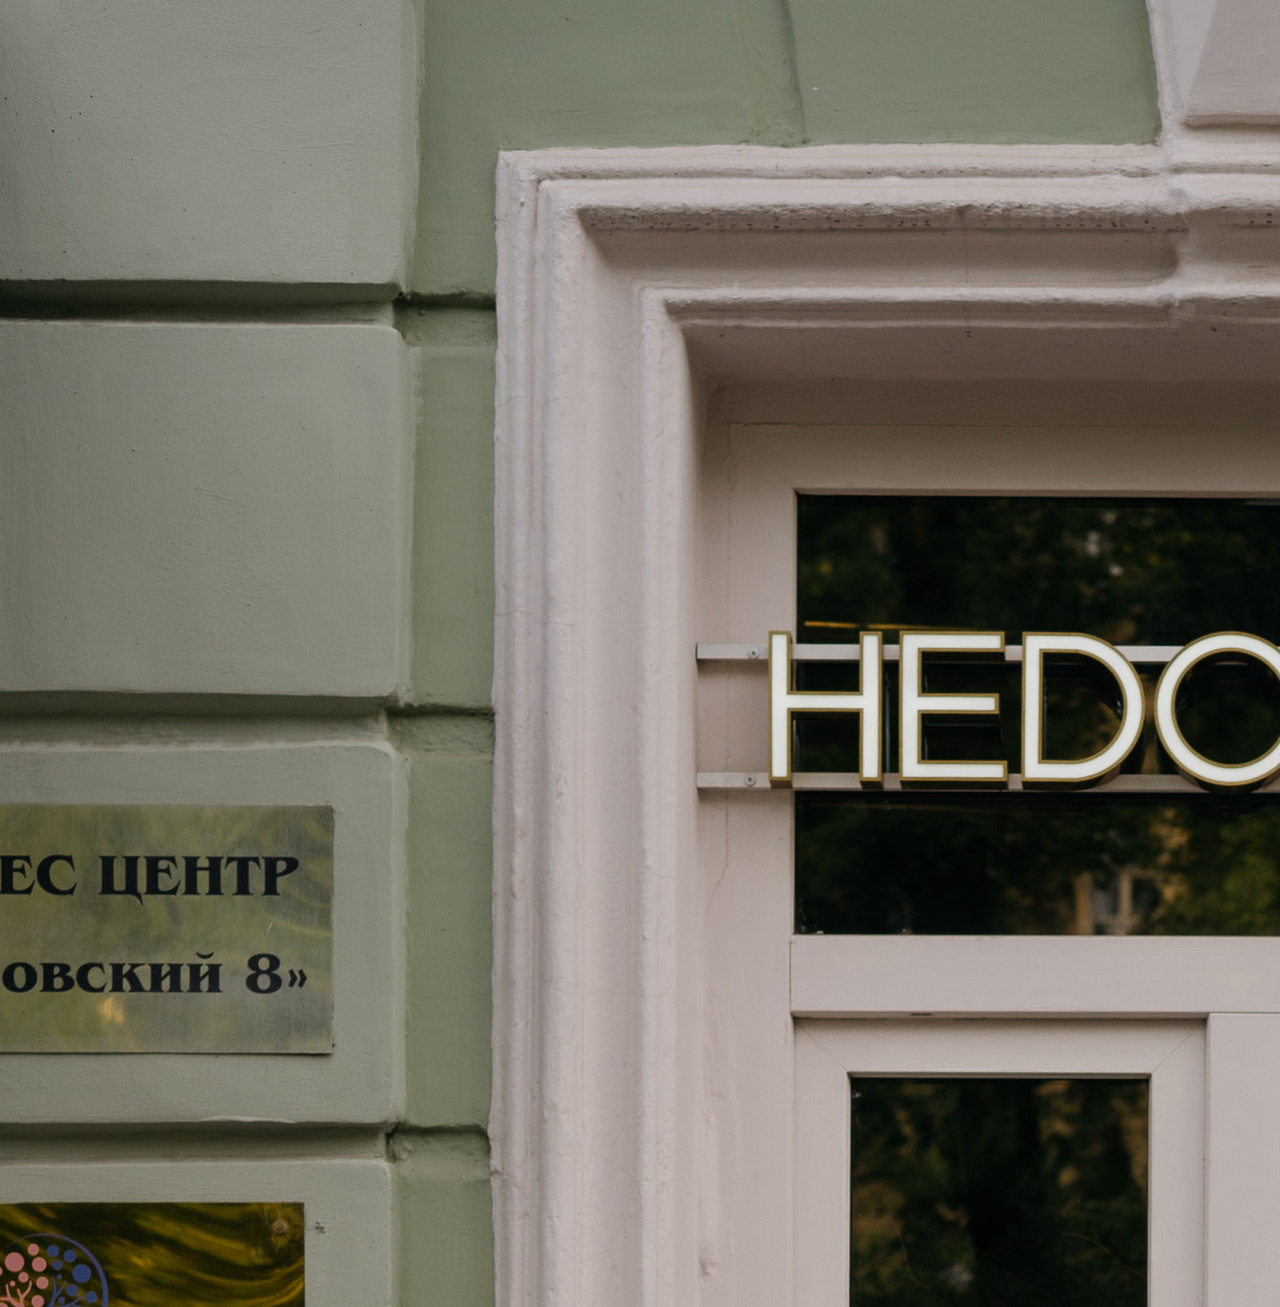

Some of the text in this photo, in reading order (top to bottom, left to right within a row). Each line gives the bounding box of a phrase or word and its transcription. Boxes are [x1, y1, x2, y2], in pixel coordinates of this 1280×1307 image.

[98, 855, 299, 907] ЦЕНТР
[1, 951, 308, 994] овский 8»
